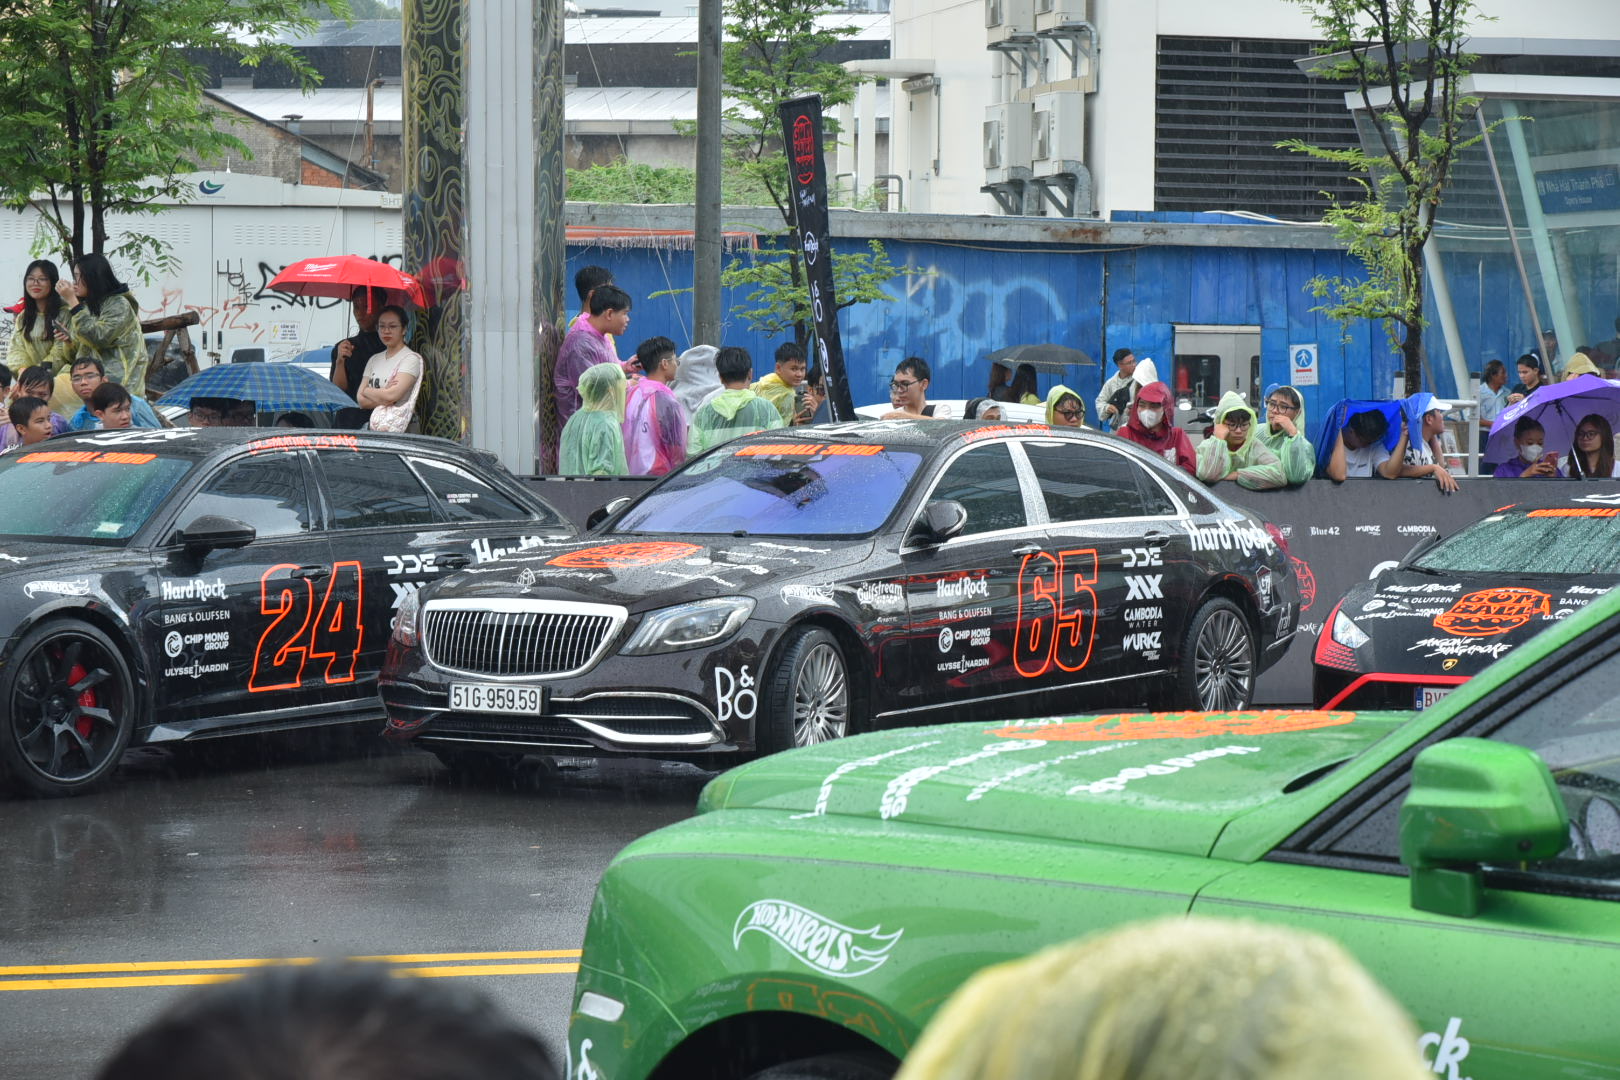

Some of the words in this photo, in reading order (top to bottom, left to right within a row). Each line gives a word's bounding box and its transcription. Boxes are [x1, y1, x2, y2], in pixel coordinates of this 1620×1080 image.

[1181, 519, 1232, 552] Hard
[1328, 526, 1341, 536] 42
[1397, 525, 1437, 533] CAMBODIA
[162, 580, 194, 600] Hard
[195, 577, 229, 601] Rock
[936, 577, 962, 598] Hard
[963, 575, 990, 599] Rock
[1559, 598, 1589, 606] BANG
[164, 613, 187, 625] BANG
[188, 612, 194, 623] &
[195, 610, 231, 622] OLUFSEN
[939, 610, 957, 621] BANG
[964, 607, 992, 618] OLUFSEN
[1013, 548, 1098, 678] 65
[1124, 606, 1163, 622] CAMBODIA
[248, 560, 364, 693] 24
[184, 634, 203, 645] CHIP
[204, 632, 229, 643] MONG
[954, 631, 971, 641] CHIP
[970, 628, 991, 639] MONG
[1123, 631, 1162, 652] WURKZ
[204, 641, 229, 651] GROUP
[970, 637, 990, 647] GROUP
[165, 667, 193, 677] ULYSSE
[199, 663, 229, 673] NARDIN
[937, 661, 961, 671] ULYSSE
[965, 658, 990, 668] NARDIN
[451, 685, 538, 710] 51G-959.59
